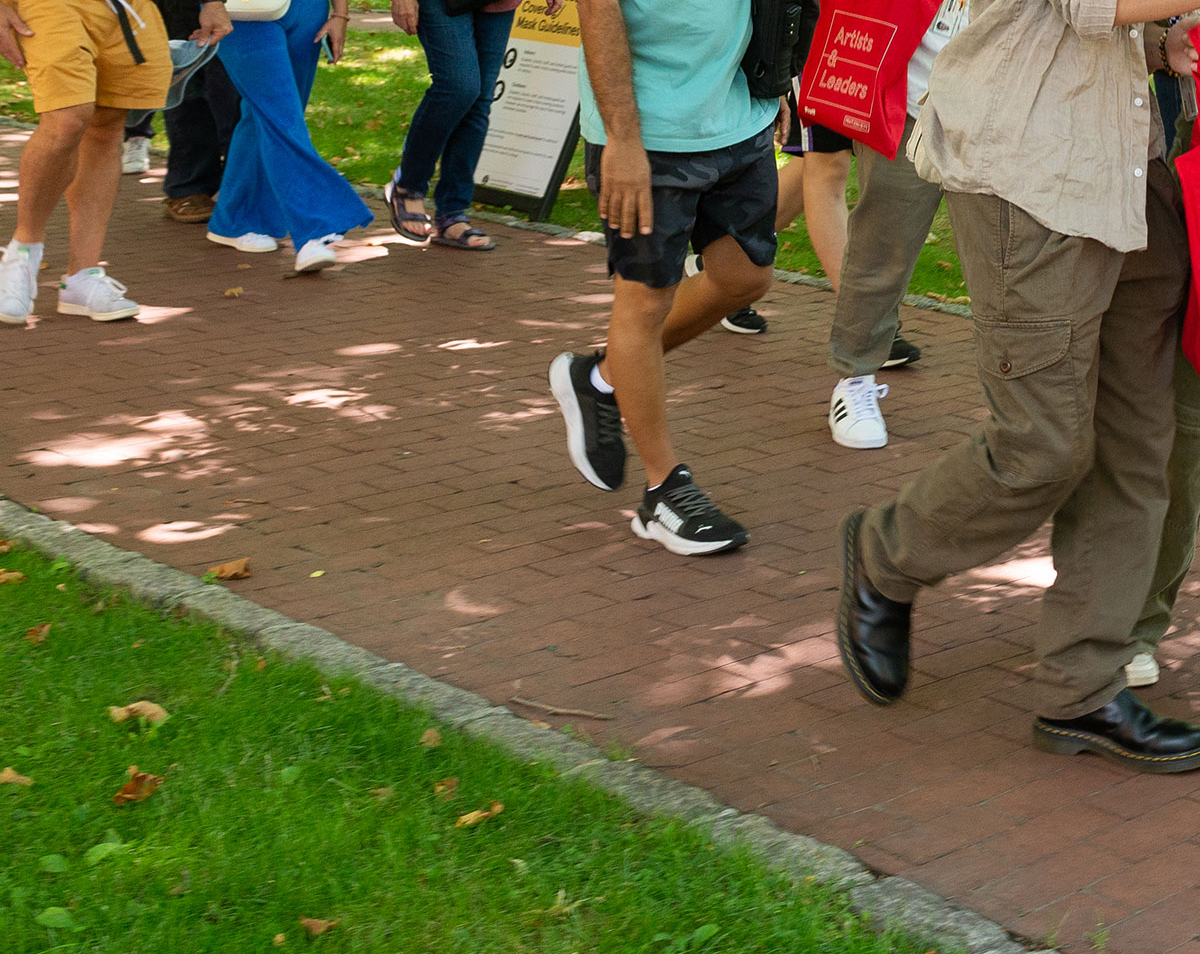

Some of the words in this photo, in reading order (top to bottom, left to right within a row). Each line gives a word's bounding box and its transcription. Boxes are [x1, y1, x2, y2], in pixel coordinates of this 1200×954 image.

[516, 16, 537, 30] Mask
[538, 19, 581, 37] Guidelines
[833, 26, 874, 53] Artists
[826, 49, 838, 68] &
[818, 69, 869, 100] Leaders
